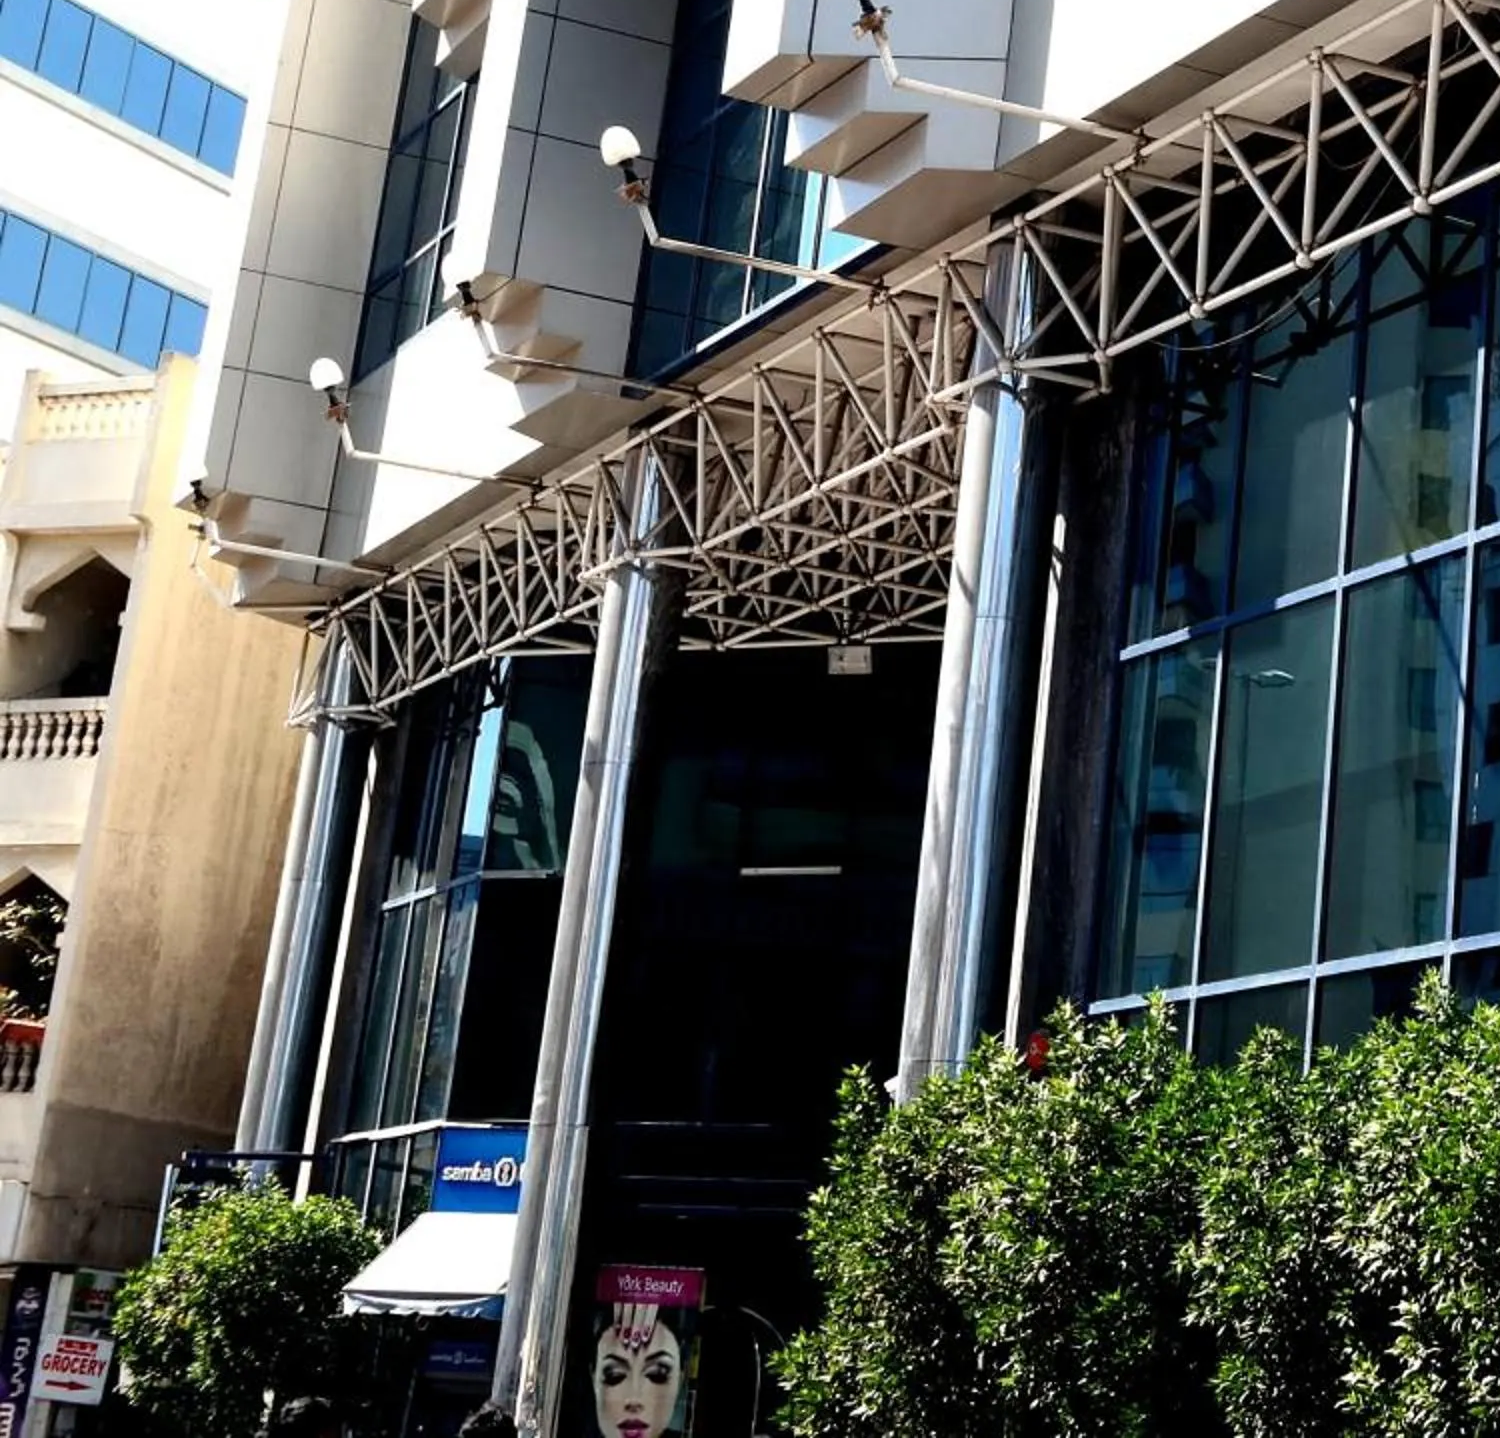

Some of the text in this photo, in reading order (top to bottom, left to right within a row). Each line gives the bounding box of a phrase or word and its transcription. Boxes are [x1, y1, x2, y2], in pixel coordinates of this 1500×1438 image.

[442, 1160, 493, 1181] samba
[644, 1276, 685, 1297] Beauty
[41, 1353, 107, 1378] GROCERY
